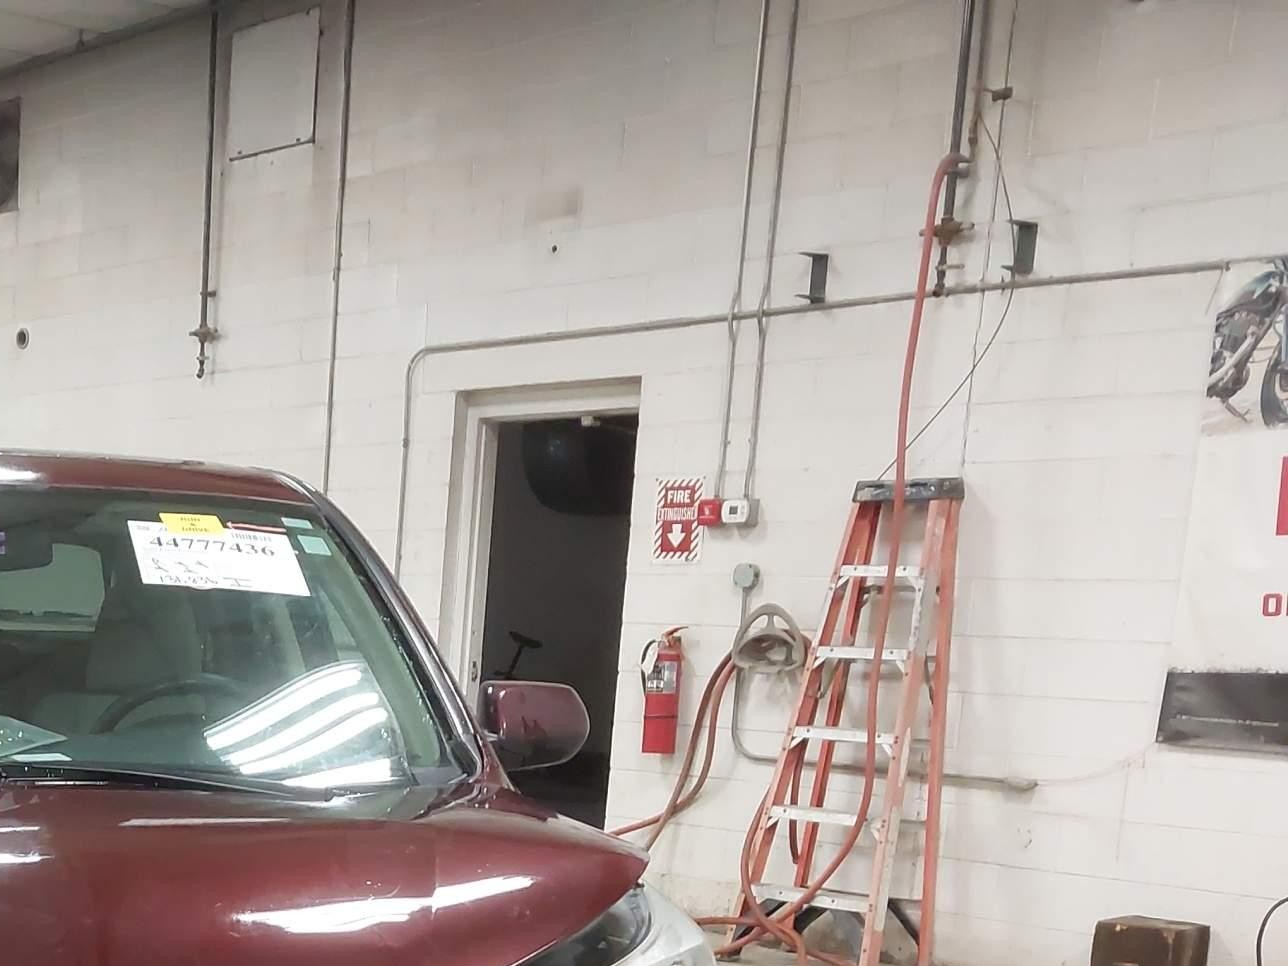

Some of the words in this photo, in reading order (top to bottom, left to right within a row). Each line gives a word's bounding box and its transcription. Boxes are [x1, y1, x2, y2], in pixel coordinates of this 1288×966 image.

[667, 489, 692, 504] FIRE
[150, 536, 275, 557] 44777436
[1262, 593, 1288, 617] O
